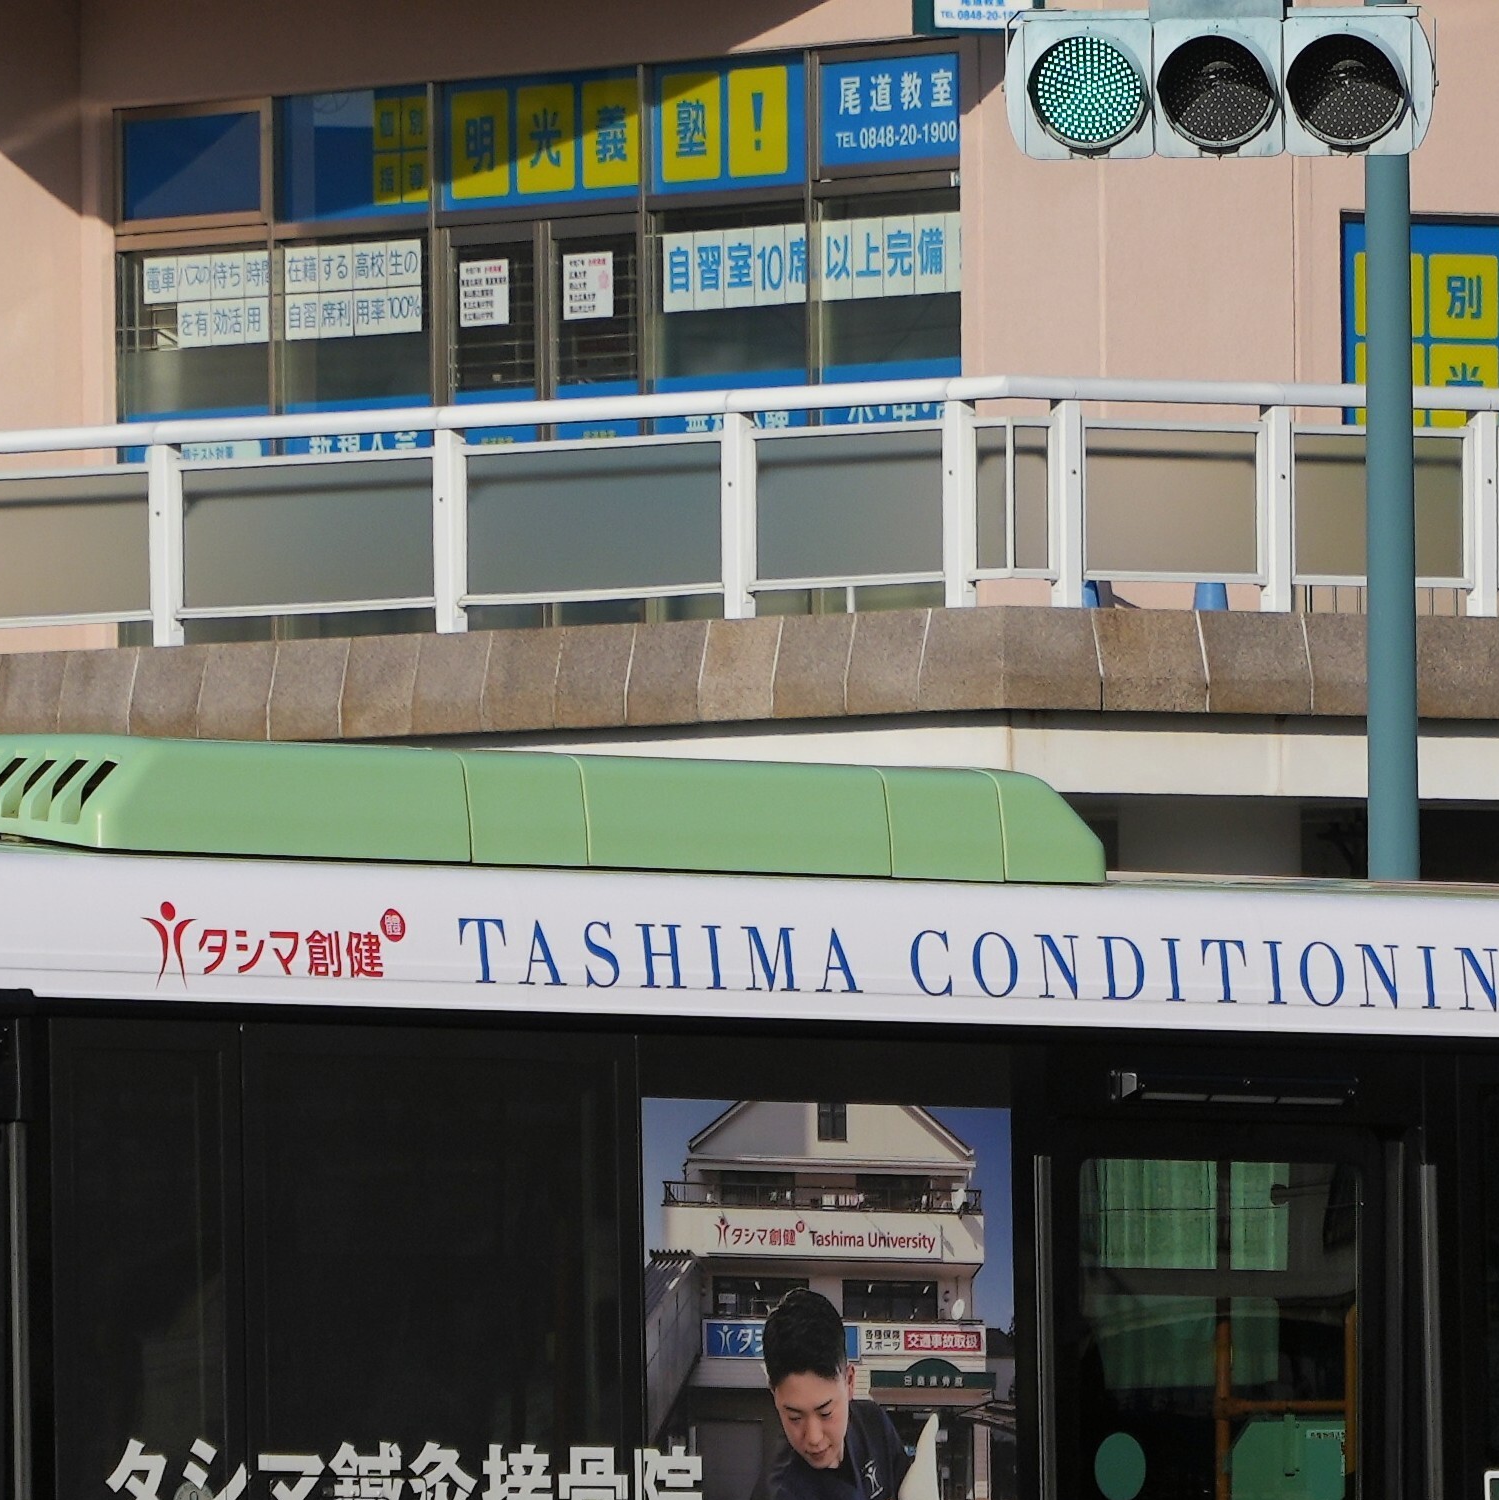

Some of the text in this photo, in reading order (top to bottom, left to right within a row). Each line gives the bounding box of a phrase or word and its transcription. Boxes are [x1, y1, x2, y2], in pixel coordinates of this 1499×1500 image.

[839, 69, 953, 115] 尾道教室
[836, 120, 957, 149] TEL 0848-20-1900
[287, 250, 418, 284] 在籍する高校生の
[181, 306, 261, 337] を有効活用
[288, 292, 421, 330] 自習席利用率100%
[199, 927, 384, 978] タシマ創健
[458, 917, 863, 994] TASHIMA
[732, 1228, 936, 1254] タシマ創健 Tashima University
[865, 1341, 900, 1351] スポーツ
[907, 1332, 979, 1351] 交通事故取扱
